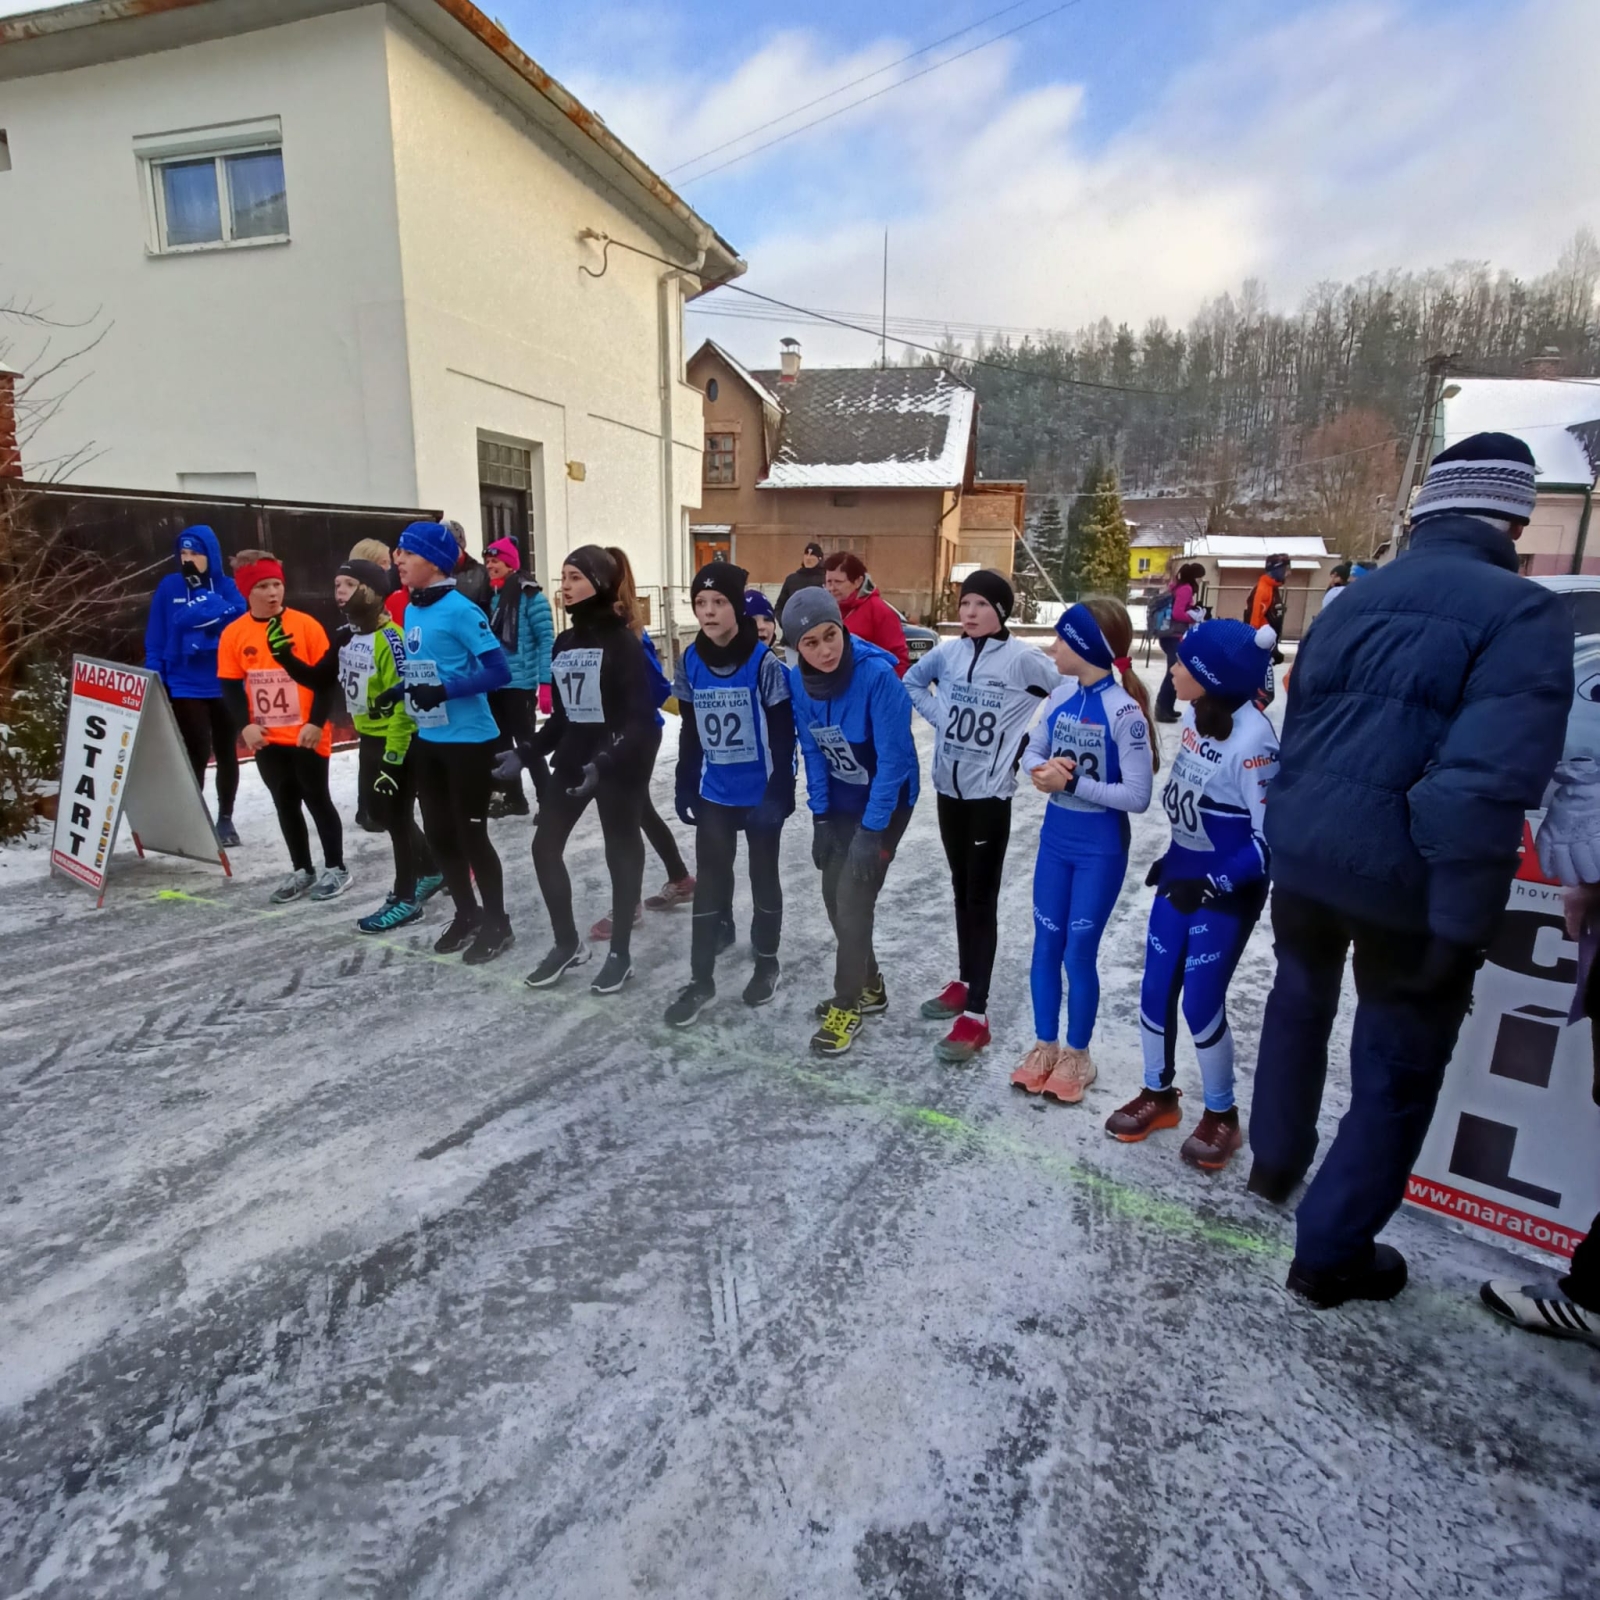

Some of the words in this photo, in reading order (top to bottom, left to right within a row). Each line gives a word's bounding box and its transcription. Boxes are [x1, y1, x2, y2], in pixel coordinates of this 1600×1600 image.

[75, 661, 147, 697] MARATON
[1192, 656, 1221, 685] OlfinCar
[255, 687, 290, 714] 64
[561, 672, 586, 705] 17
[729, 699, 749, 708] LIGA
[982, 699, 1001, 709] LIGA
[1116, 703, 1140, 717] Olfin
[704, 712, 744, 747] 92
[945, 705, 997, 747] 208
[1079, 738, 1102, 748] LIGA
[1243, 753, 1279, 769] OlfinC
[69, 715, 107, 857] START
[1163, 779, 1198, 832] 190
[1515, 885, 1561, 901] hovn
[1185, 951, 1221, 968] lfinCar
[1408, 1180, 1582, 1252] ww.maratons
